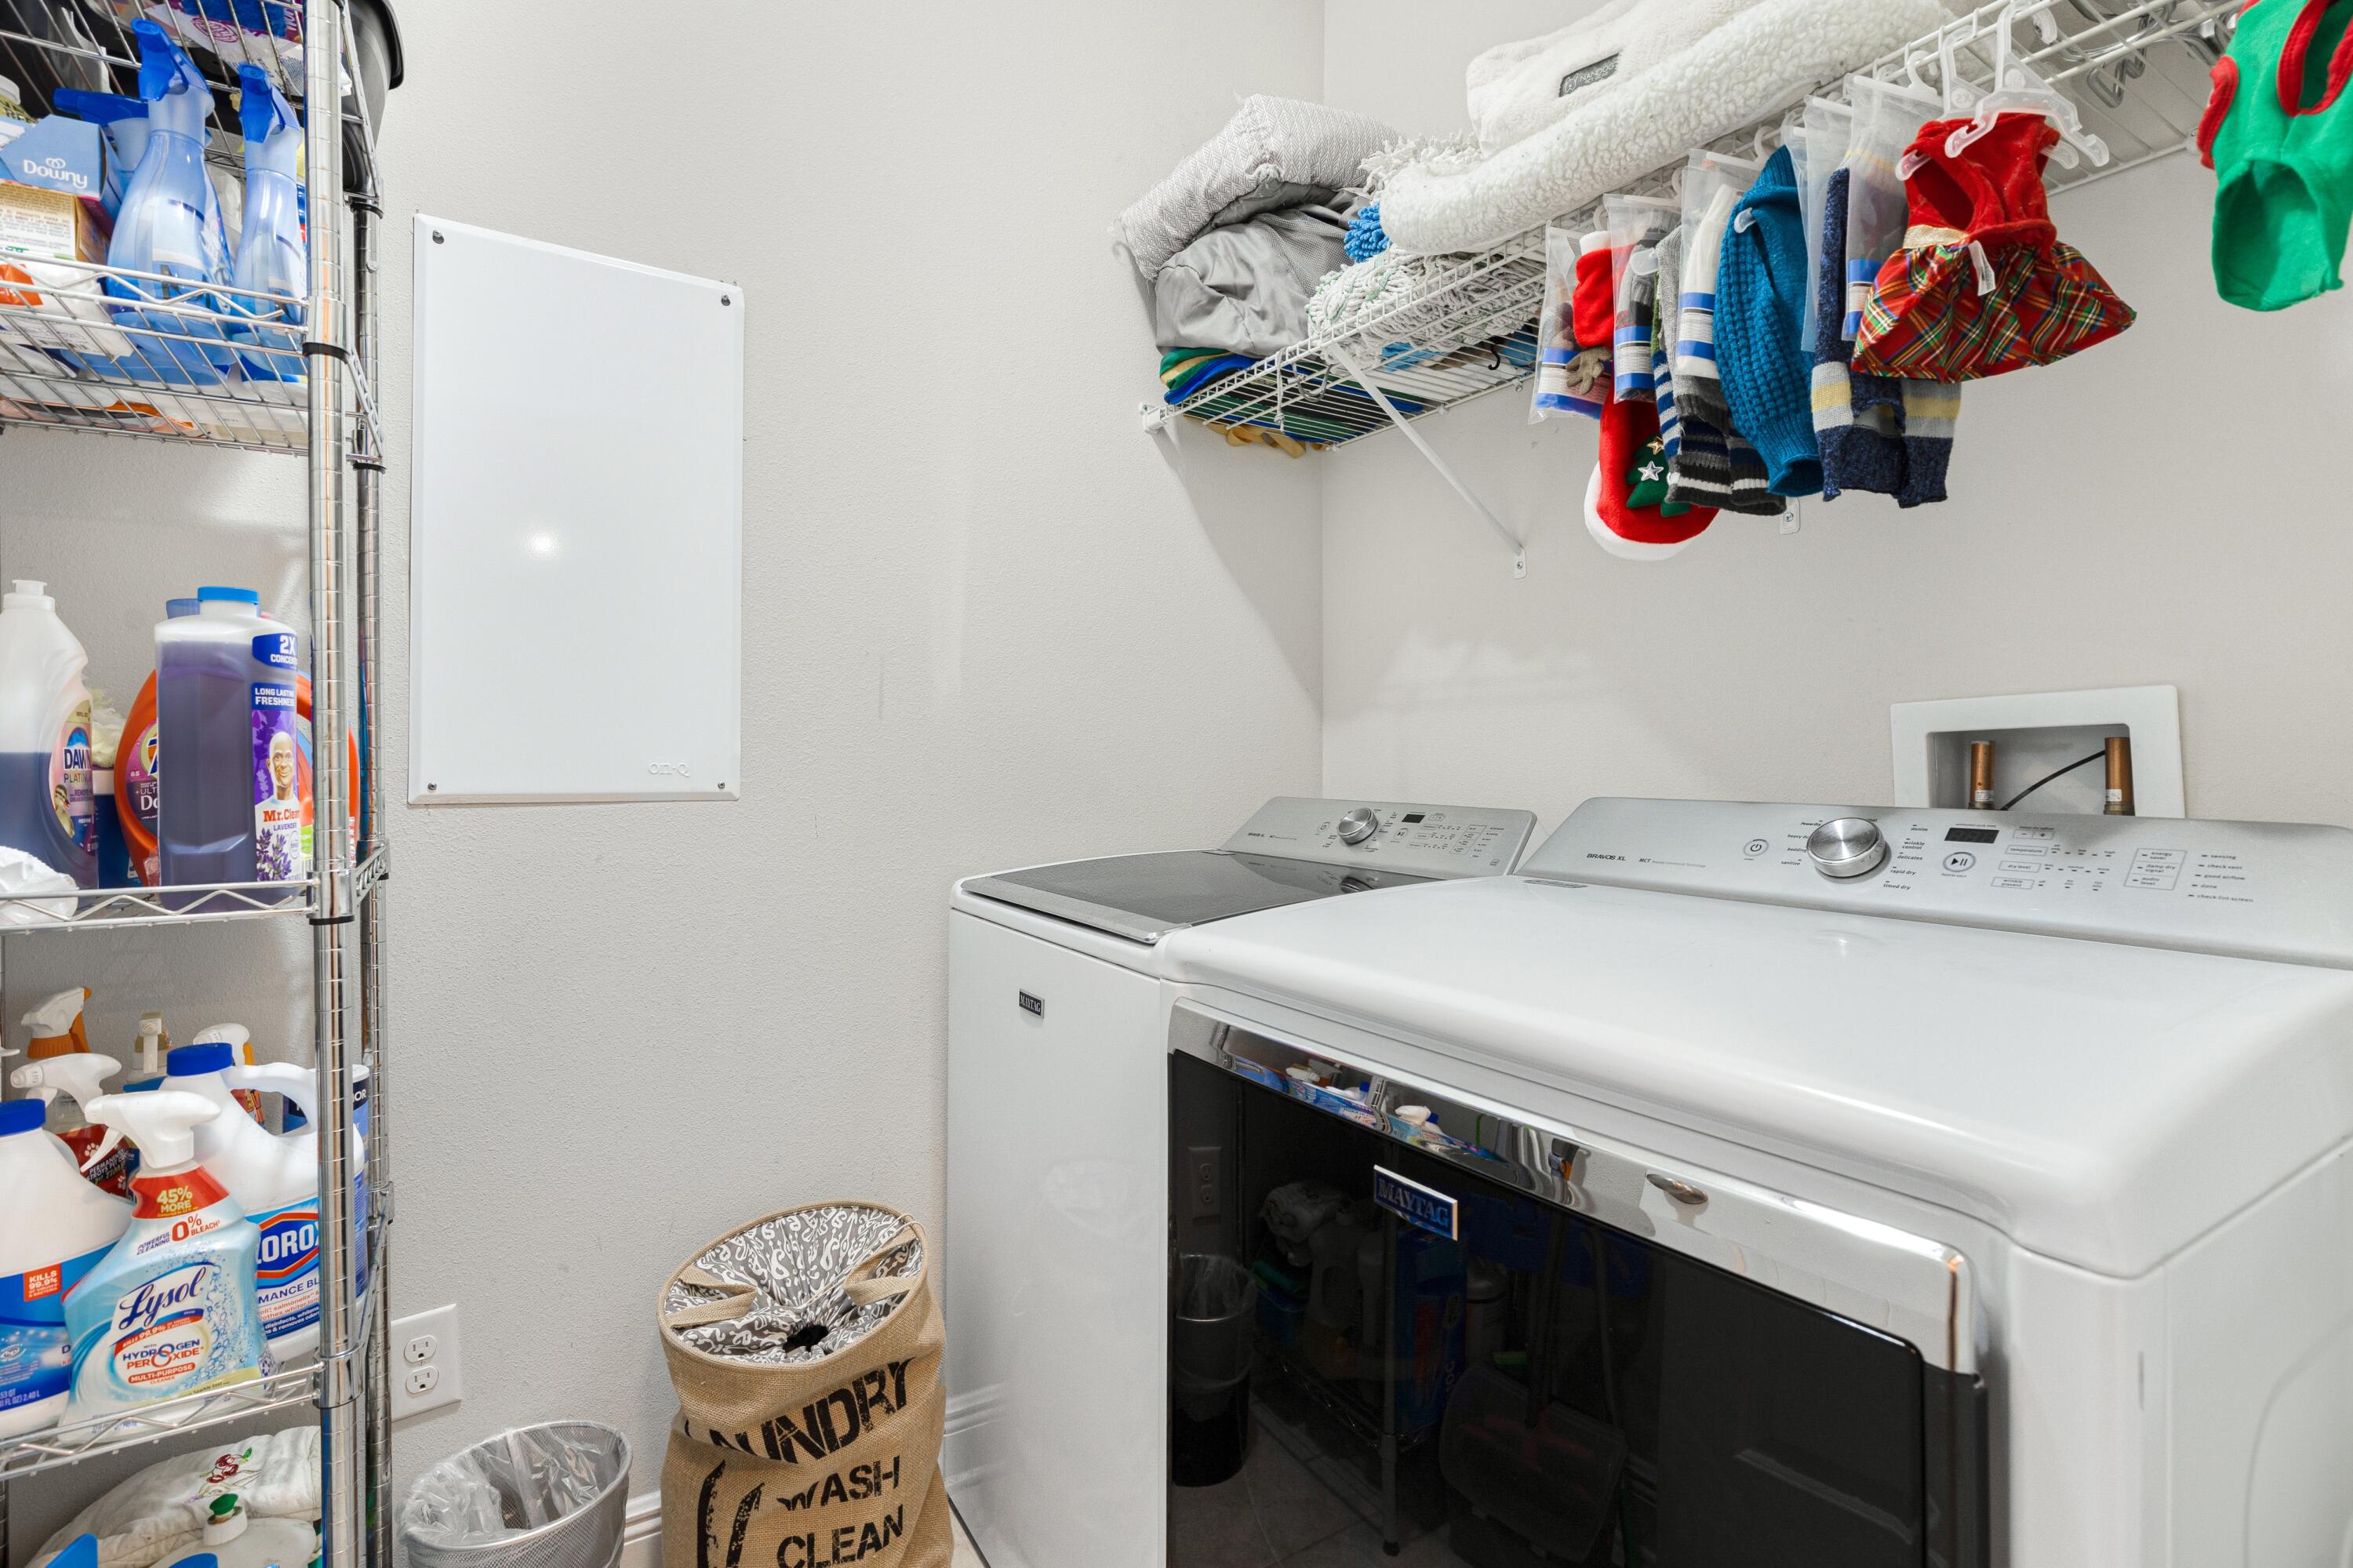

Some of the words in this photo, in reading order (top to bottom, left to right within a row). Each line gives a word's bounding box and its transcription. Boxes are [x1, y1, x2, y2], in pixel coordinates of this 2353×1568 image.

[1580, 63, 1615, 82] NANDOG
[23, 158, 88, 189] Downy
[279, 635, 296, 656] 2X
[255, 687, 275, 696] LONG
[1020, 994, 1041, 1013] MAYTAG
[156, 1185, 193, 1205] 45%
[1378, 1178, 1449, 1228] MAYTAG
[160, 1199, 192, 1213] MORE
[172, 1213, 202, 1242] 0%
[136, 1238, 170, 1255] CLEANING
[137, 1231, 170, 1250] POWERFUL
[28, 1278, 58, 1290] 99.9%
[29, 1270, 57, 1283] KILLS
[118, 1266, 207, 1330] Lysol
[258, 1282, 304, 1304] MANCE
[285, 1303, 307, 1314] whiter
[139, 1325, 166, 1340] 99.9%
[278, 1318, 305, 1330] removes
[122, 1339, 201, 1362] HYDROGEN
[126, 1348, 201, 1370] PEROXIDE
[130, 1363, 194, 1382] MULTI-PURPOSE
[150, 1375, 175, 1384] CLEANER
[5, 1397, 12, 1406] FL
[24, 1391, 36, 1402] 2.40
[8, 1388, 16, 1396] QT
[776, 1455, 900, 1512] WASH
[776, 1504, 904, 1568] CLEAN
